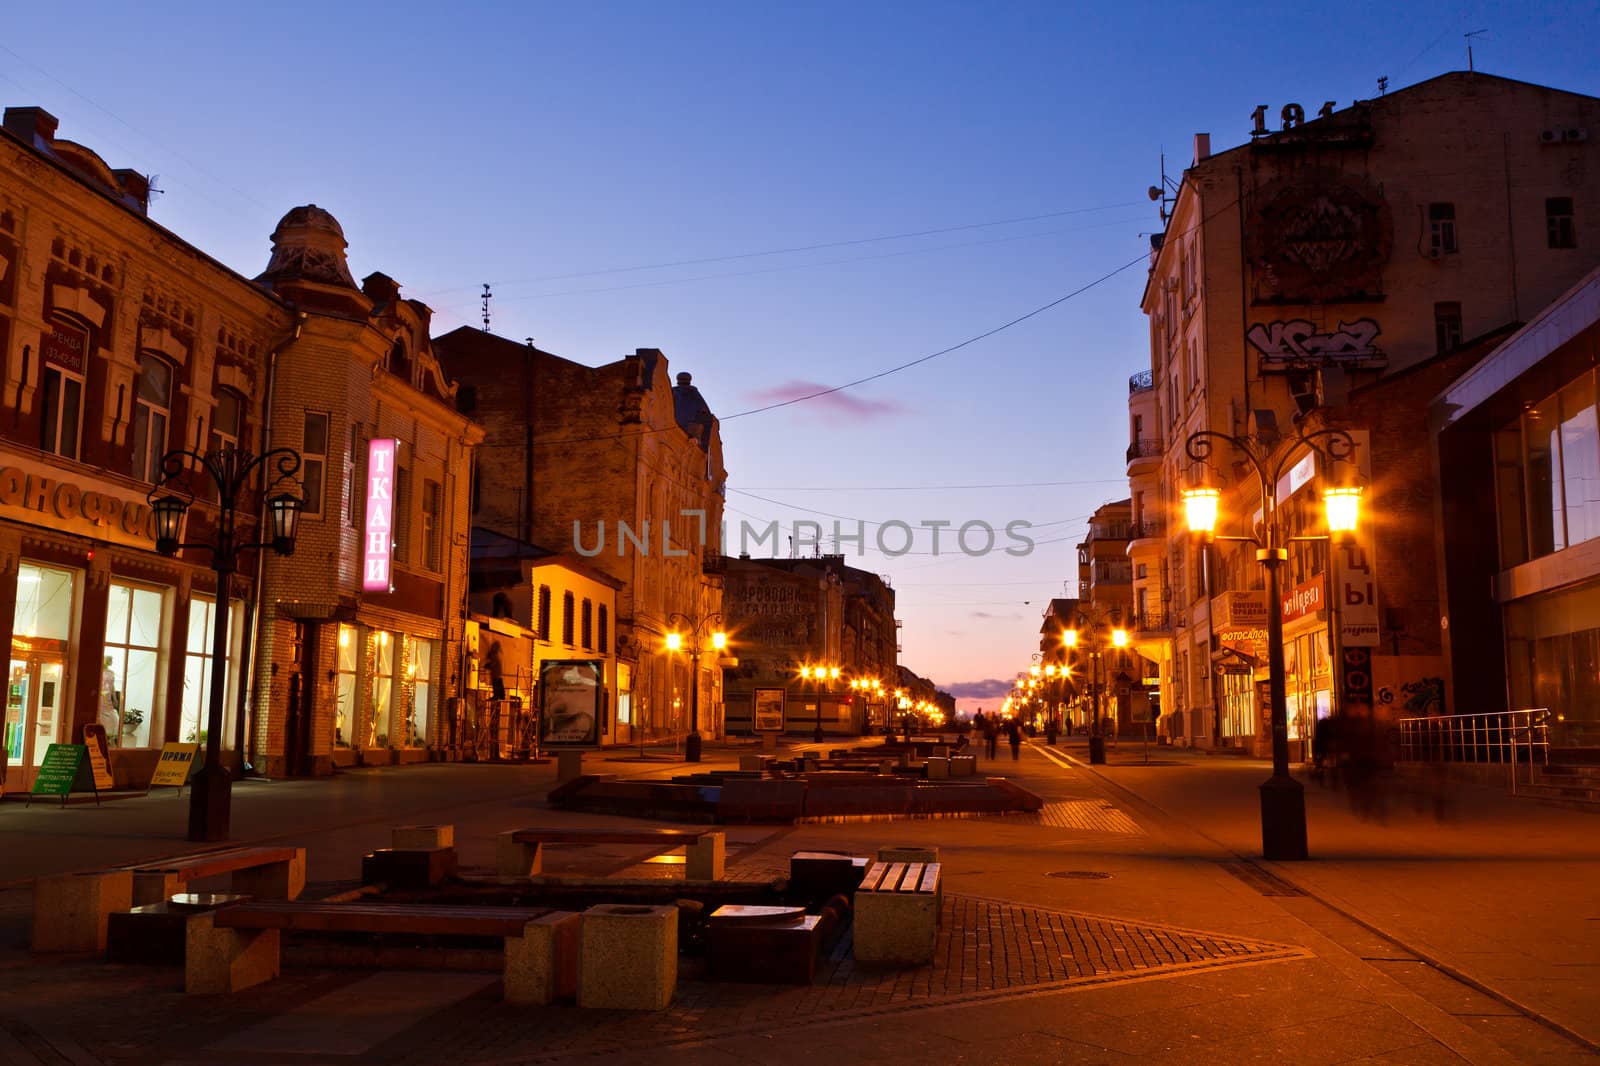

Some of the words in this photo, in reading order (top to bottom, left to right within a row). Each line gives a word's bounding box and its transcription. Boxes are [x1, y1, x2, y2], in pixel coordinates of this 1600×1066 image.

[49, 330, 82, 350] РЕНДА
[367, 449, 393, 583] ТКАНИ
[161, 752, 193, 762] ПРЯЖА
